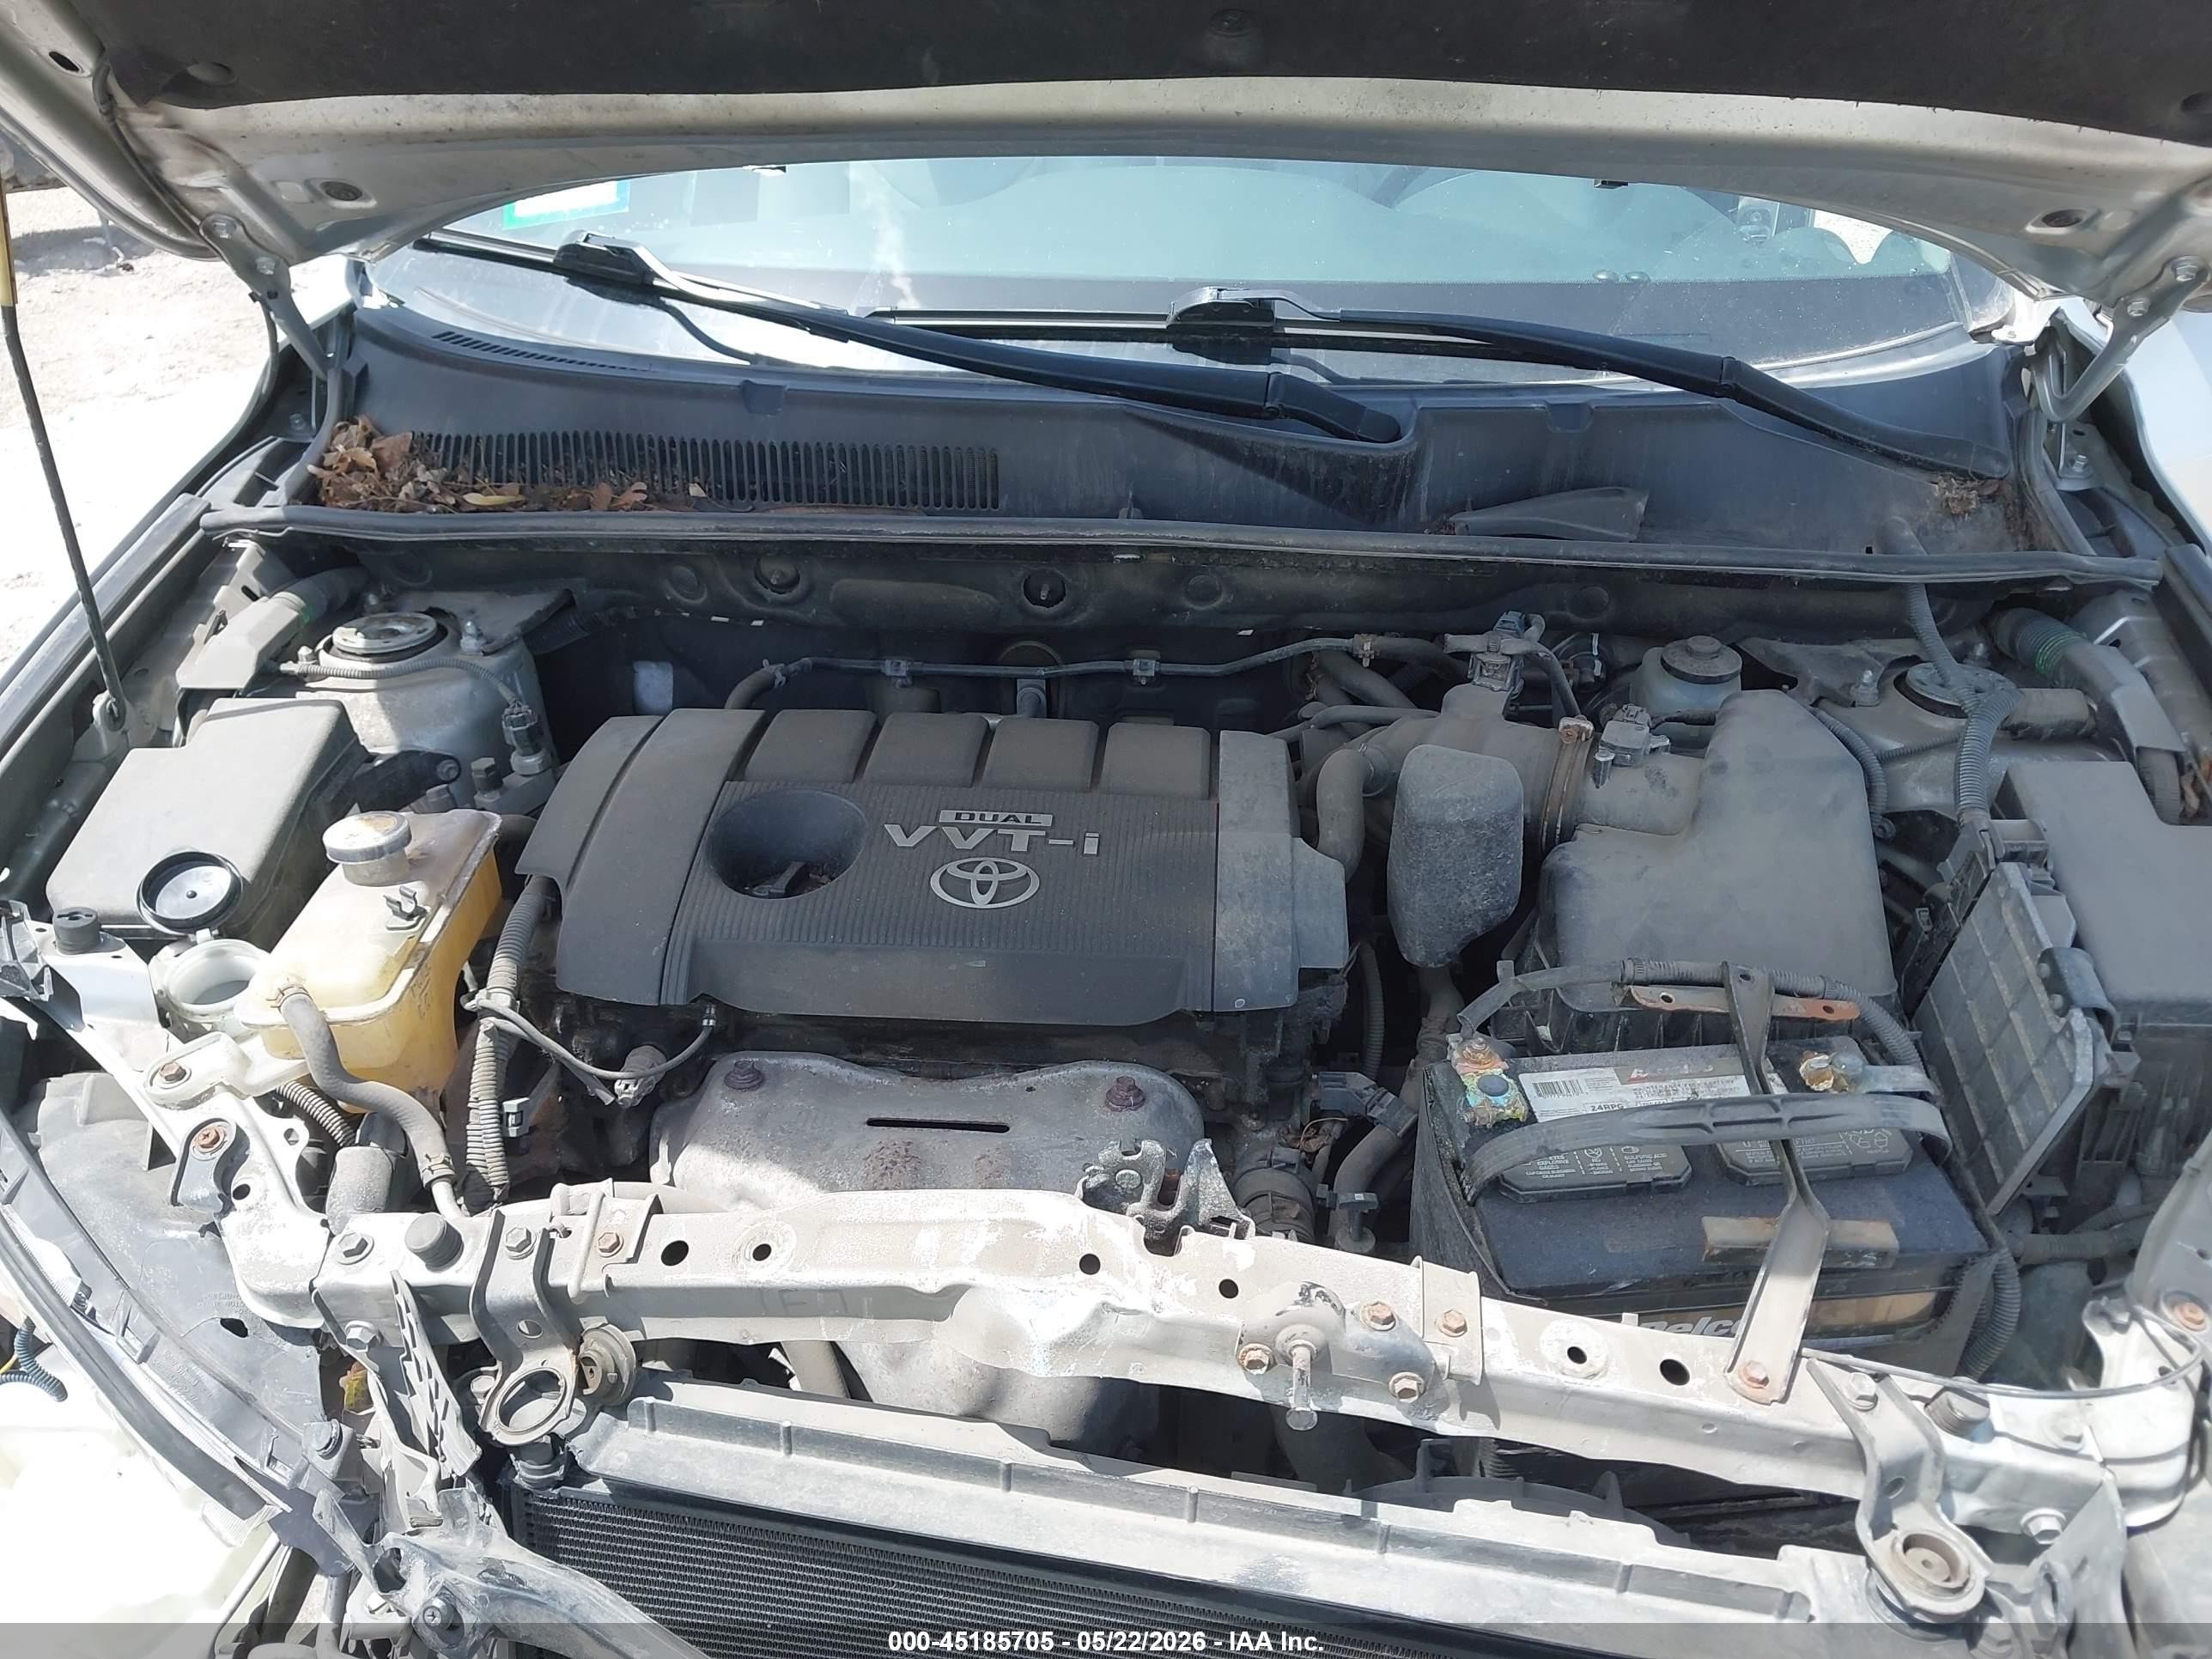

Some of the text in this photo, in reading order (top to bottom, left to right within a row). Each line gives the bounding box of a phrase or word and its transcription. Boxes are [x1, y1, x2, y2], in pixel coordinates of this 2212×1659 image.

[954, 811, 1042, 824] DUAL
[884, 823, 1100, 855] VVT-i
[1589, 1103, 1625, 1112] 24RPG
